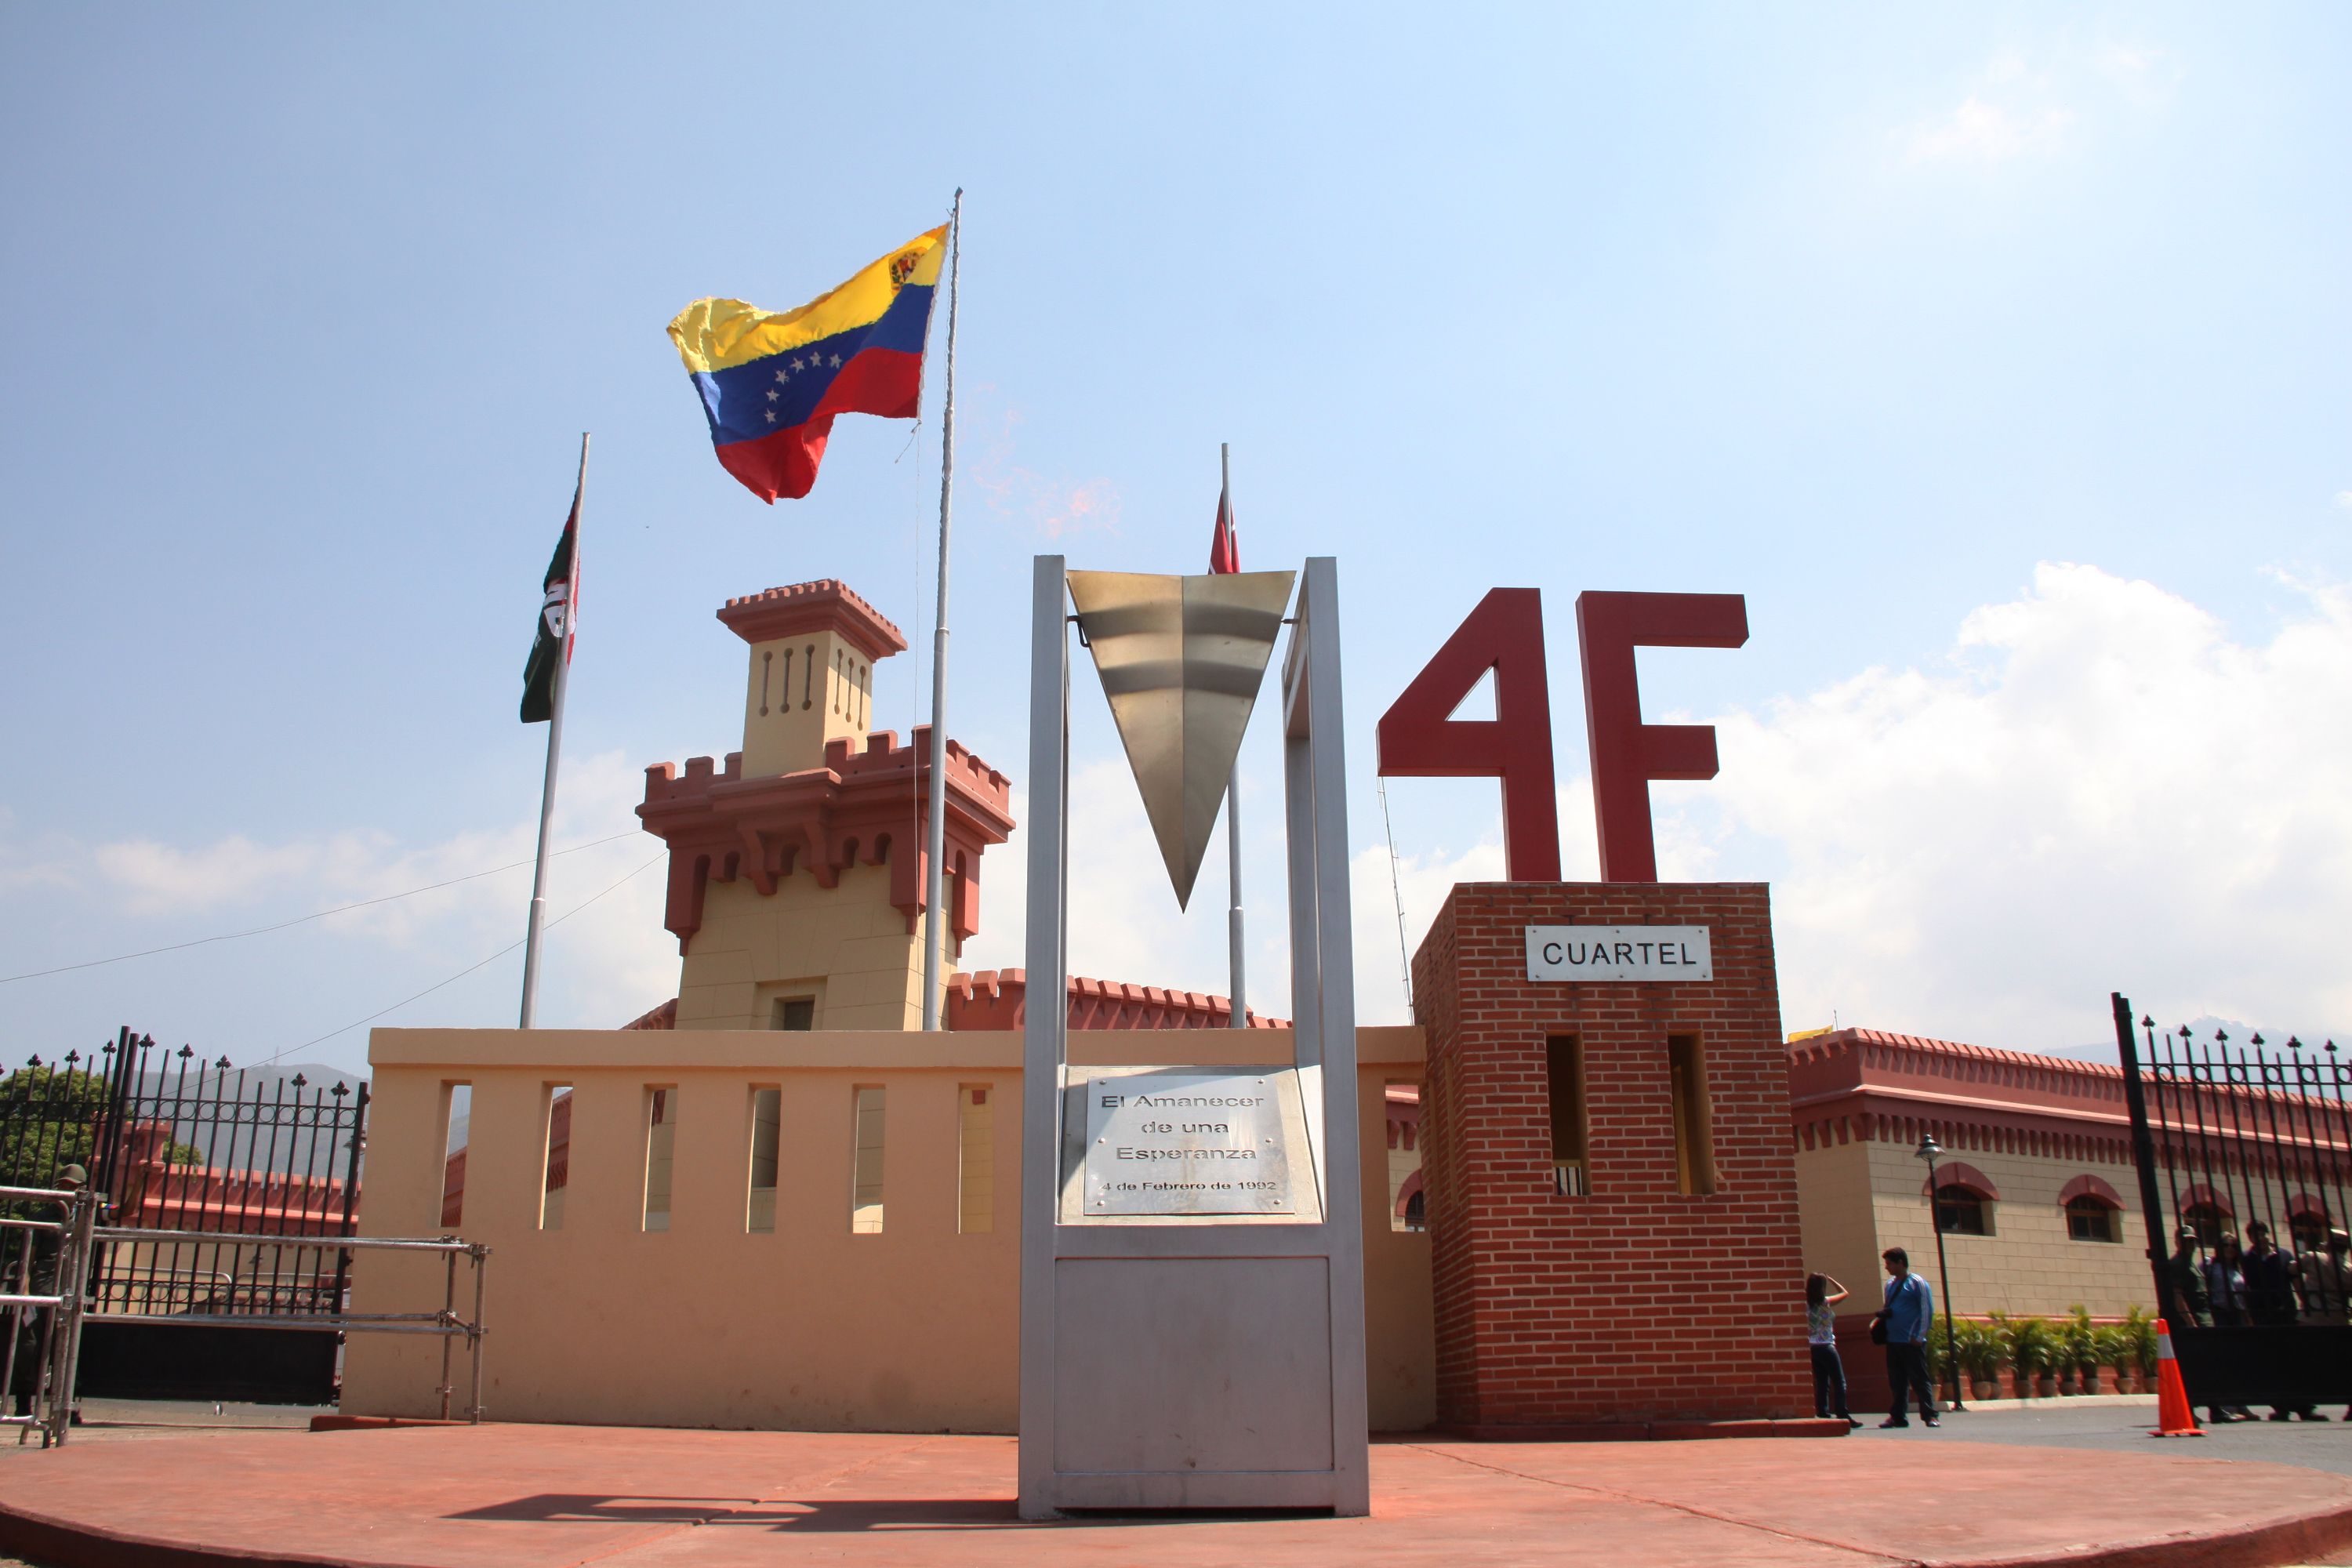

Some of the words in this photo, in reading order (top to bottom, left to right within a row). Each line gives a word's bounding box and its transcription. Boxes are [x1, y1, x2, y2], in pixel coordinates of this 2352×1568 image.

[1376, 587, 1749, 883] 4F
[1543, 942, 1697, 965] CUARTEL
[1102, 1096, 1124, 1108] El
[1134, 1095, 1264, 1107] Amanecer
[1142, 1121, 1172, 1133] de
[1182, 1123, 1229, 1133] una
[1116, 1147, 1256, 1162] Esperanza
[1100, 1182, 1111, 1191] 4
[1142, 1181, 1206, 1190] Febrero
[1211, 1181, 1231, 1190] de
[1237, 1181, 1276, 1190] 1992
